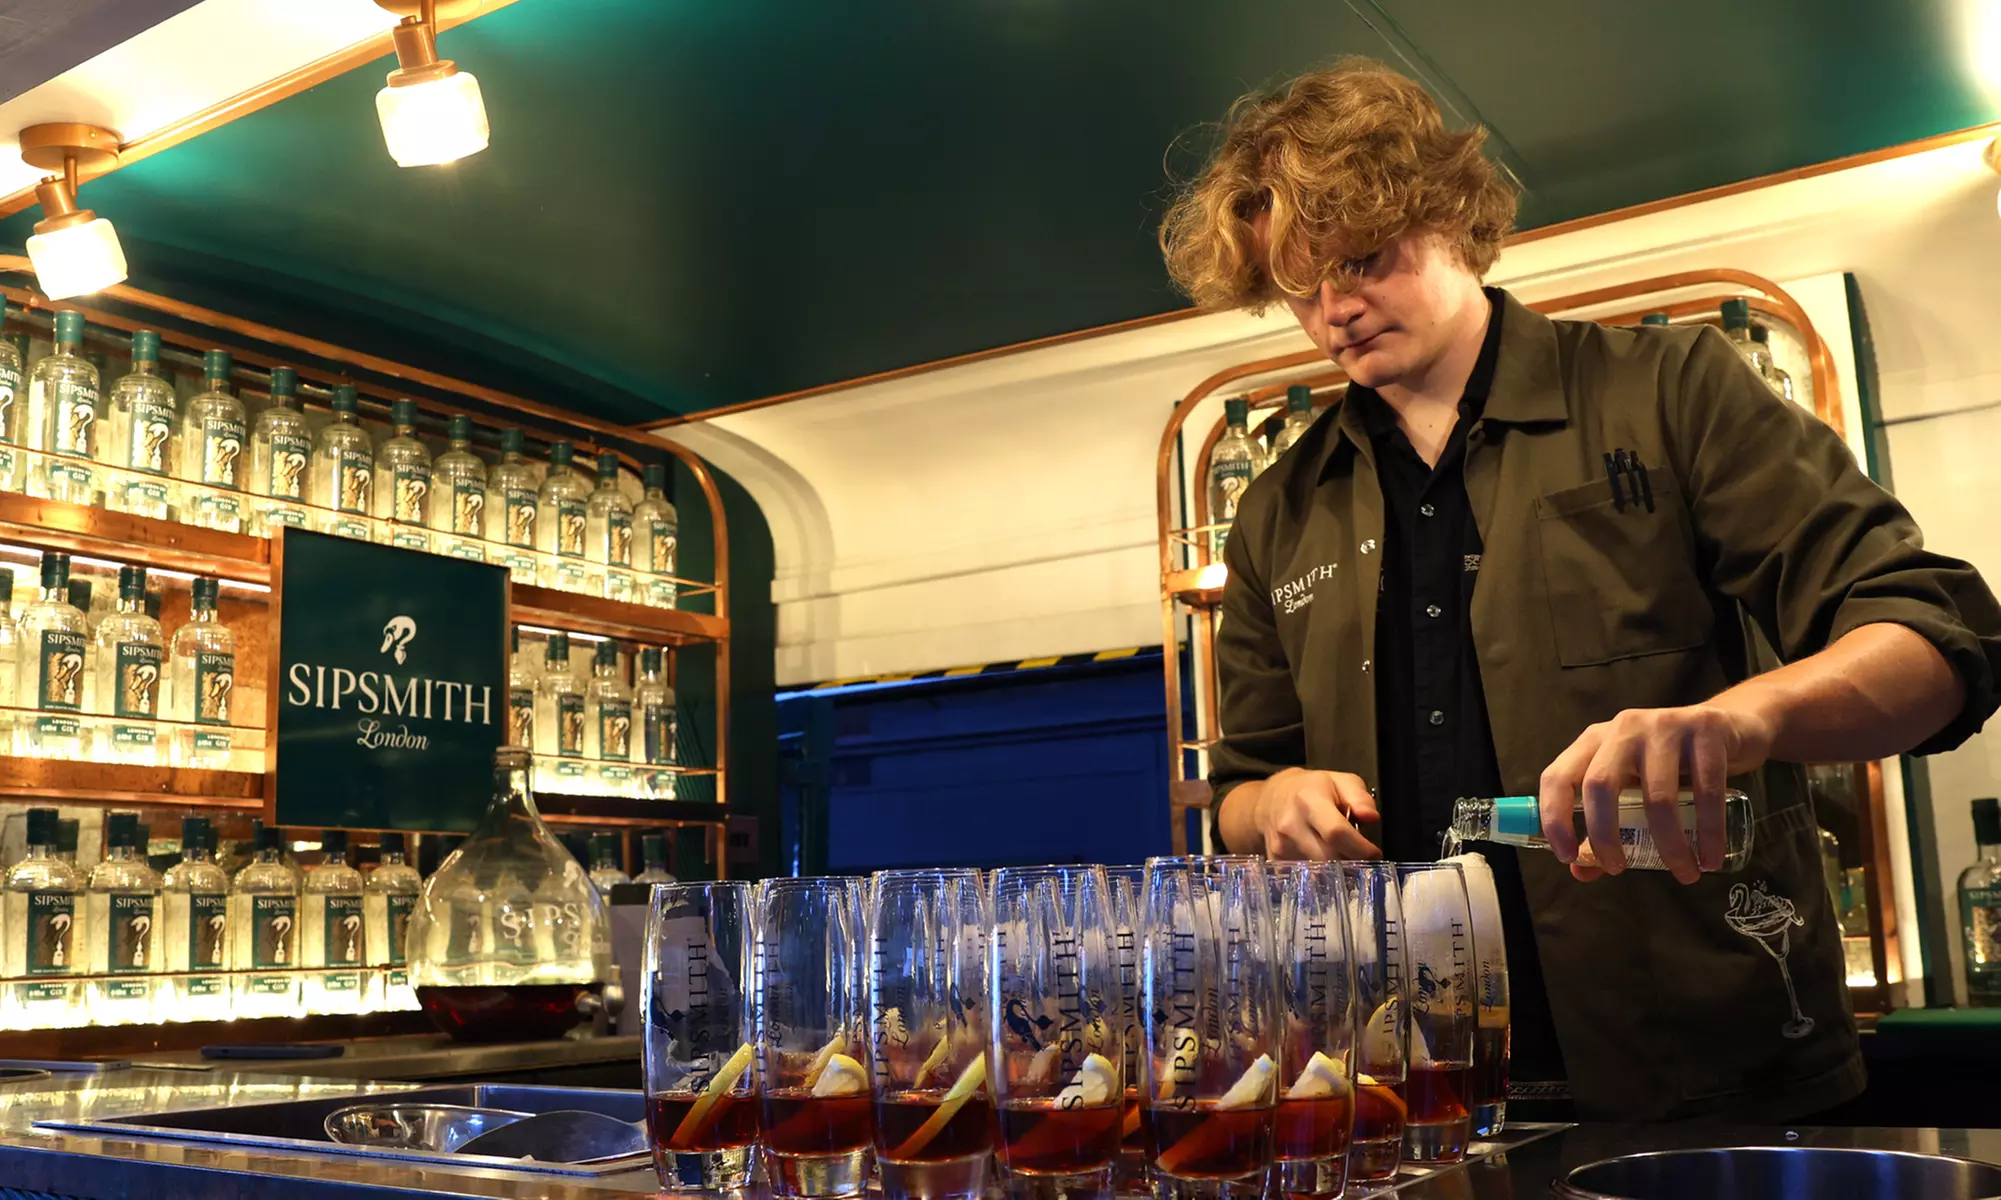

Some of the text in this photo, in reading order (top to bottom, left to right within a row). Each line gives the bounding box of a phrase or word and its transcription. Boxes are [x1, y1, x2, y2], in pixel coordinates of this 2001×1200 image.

[1271, 564, 1337, 606] IPSMITH
[288, 663, 491, 725] SIPSMITH
[356, 717, 430, 750] London
[688, 943, 711, 1094] SIPSMITH
[1055, 938, 1084, 1111] SIPSMITH
[1174, 933, 1197, 1112] SIPSMITH
[1310, 922, 1328, 1049] IPSMITH
[1451, 922, 1466, 1018] PSMITH
